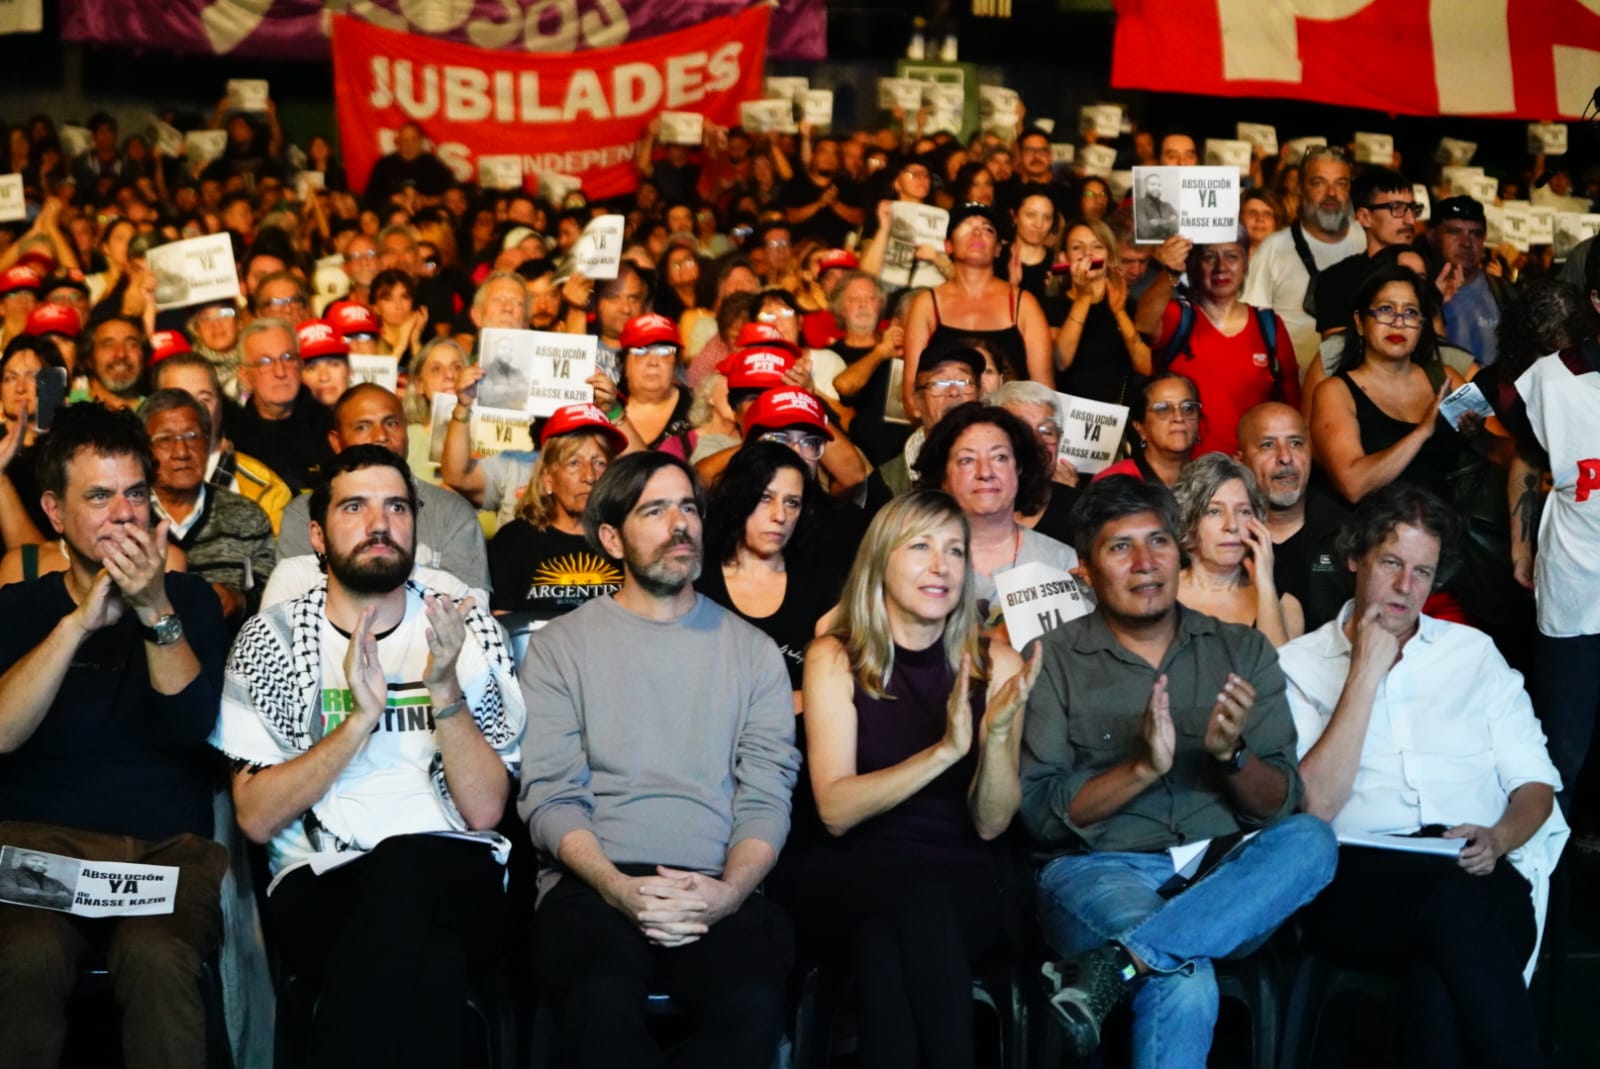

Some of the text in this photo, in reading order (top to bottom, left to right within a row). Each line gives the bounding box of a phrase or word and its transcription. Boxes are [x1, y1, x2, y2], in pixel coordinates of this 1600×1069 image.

[370, 41, 743, 122] JUBILADES
[1181, 177, 1231, 189] ABSOLUCIÓN
[1199, 189, 1217, 208] YA
[1180, 217, 1234, 227] ANASSE KAZIB
[535, 345, 587, 360] ABSOLUCIÓN
[552, 358, 570, 378] YA
[530, 386, 561, 399] ANASSE
[1070, 409, 1119, 427] ABSOLUCIÓN
[496, 423, 513, 443] YA
[1083, 422, 1101, 442] YA
[1060, 445, 1089, 458] ANASSE
[1006, 580, 1077, 607] ANASSE KAZIB
[82, 868, 164, 881] ABSOLUCIÓN
[109, 880, 138, 894] YA
[75, 897, 125, 907] ANASSE
